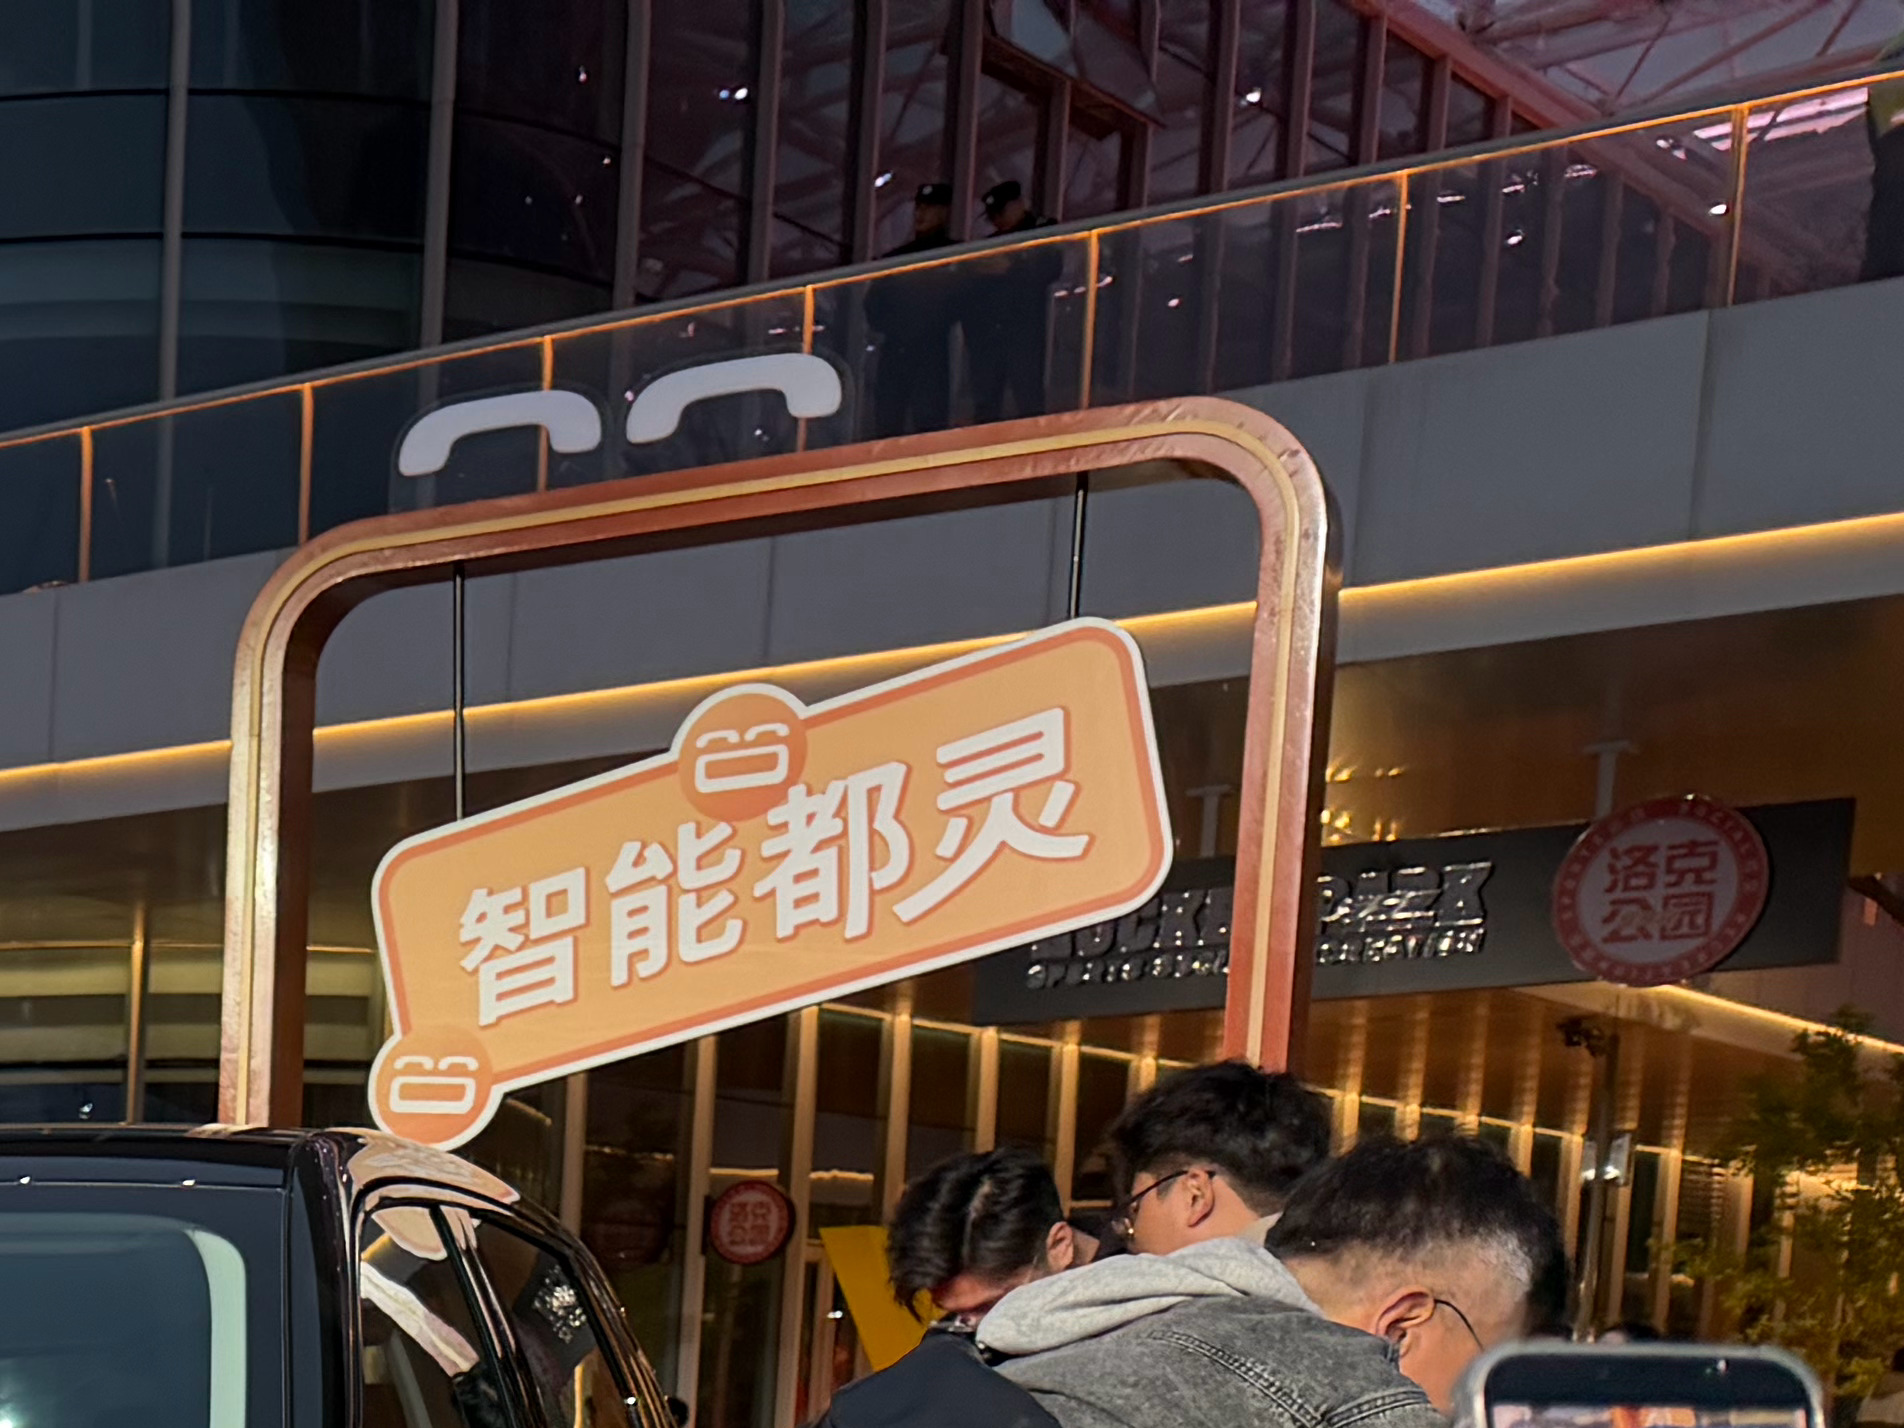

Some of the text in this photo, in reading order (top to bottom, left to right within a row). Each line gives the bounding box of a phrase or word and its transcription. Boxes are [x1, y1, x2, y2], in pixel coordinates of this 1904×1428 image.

[459, 707, 1090, 1027] 智能都灵
[1603, 839, 1719, 894] 洛克
[1601, 889, 1714, 944] 公园
